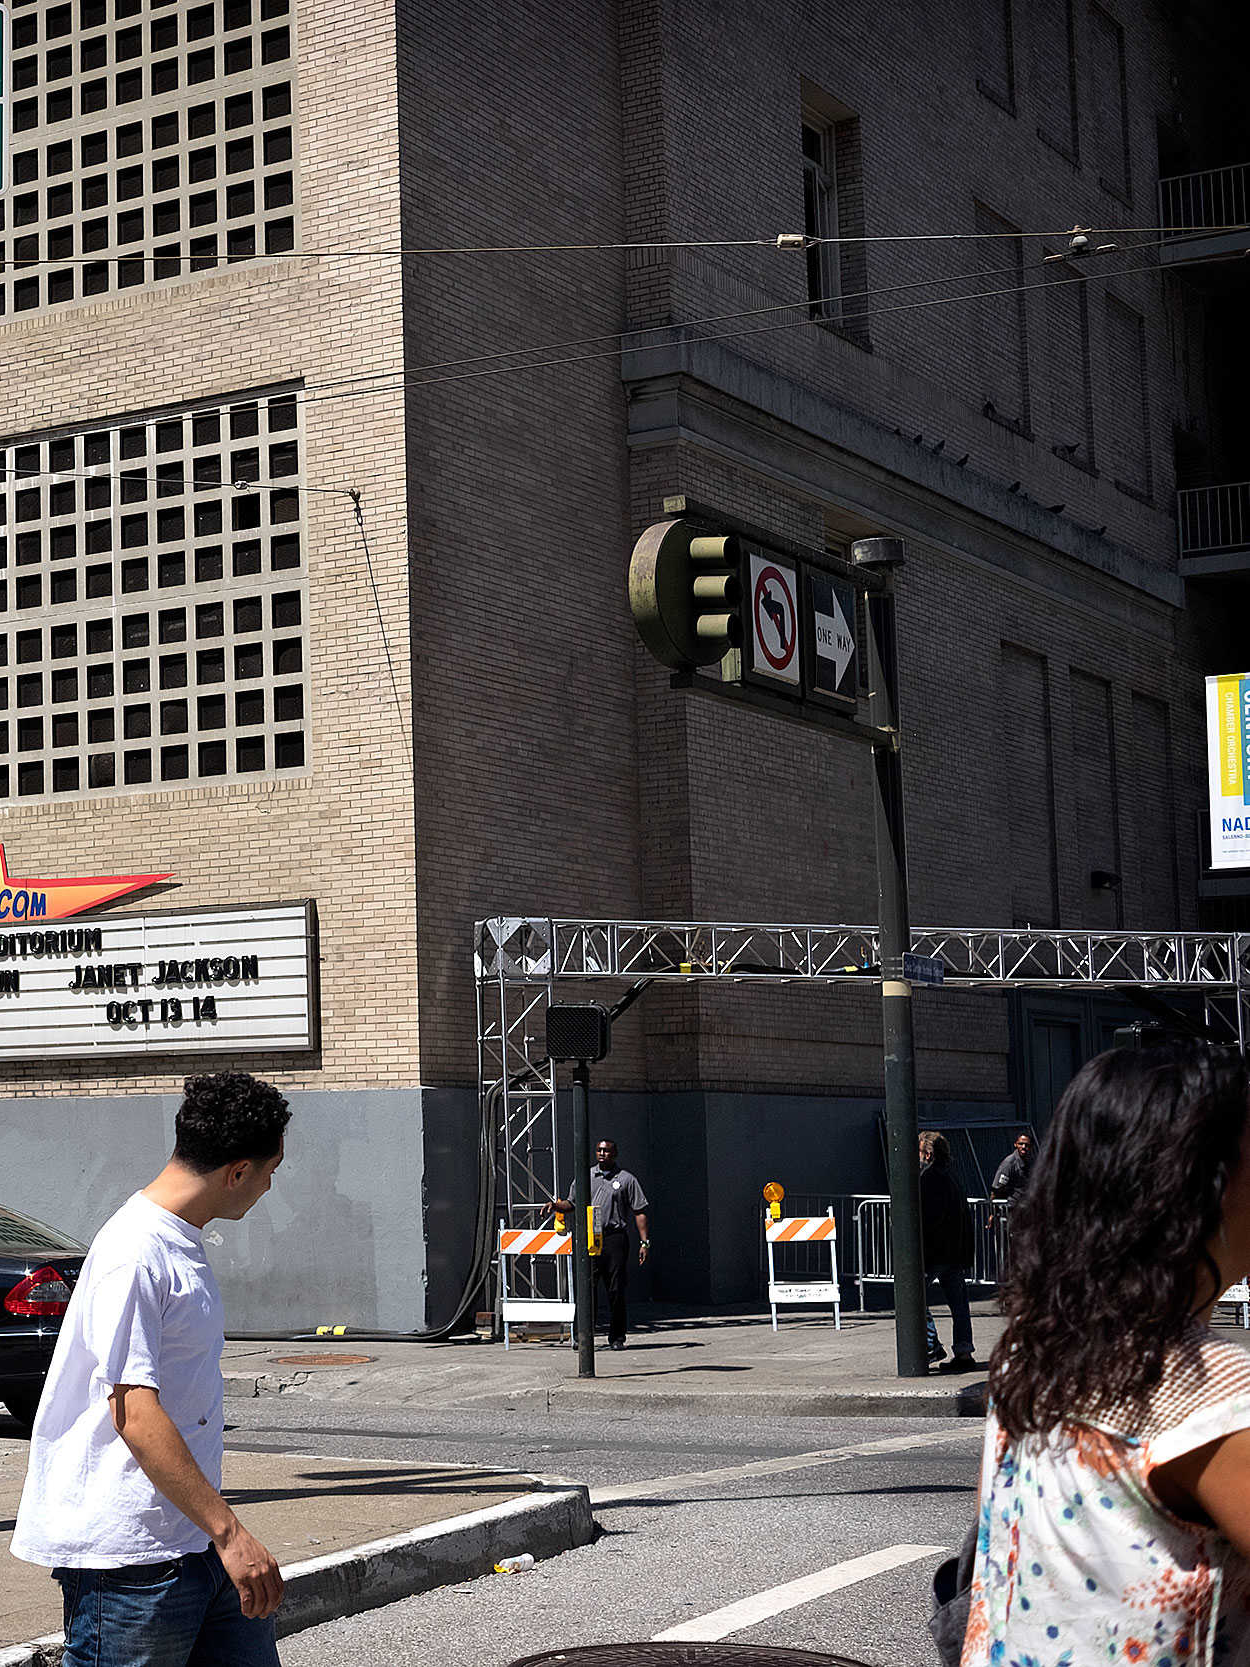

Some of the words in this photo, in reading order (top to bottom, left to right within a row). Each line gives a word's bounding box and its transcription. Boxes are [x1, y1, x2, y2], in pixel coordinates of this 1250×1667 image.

[817, 626, 832, 646] ONE
[836, 633, 851, 653] WAY
[1225, 692, 1235, 733] CHAMBER
[1227, 735, 1237, 785] ORCHESTRA
[68, 962, 142, 989] JANET
[151, 955, 259, 984] JACKSON
[106, 1000, 153, 1024] OCT
[160, 997, 183, 1022] 13
[193, 996, 217, 1021] 14
